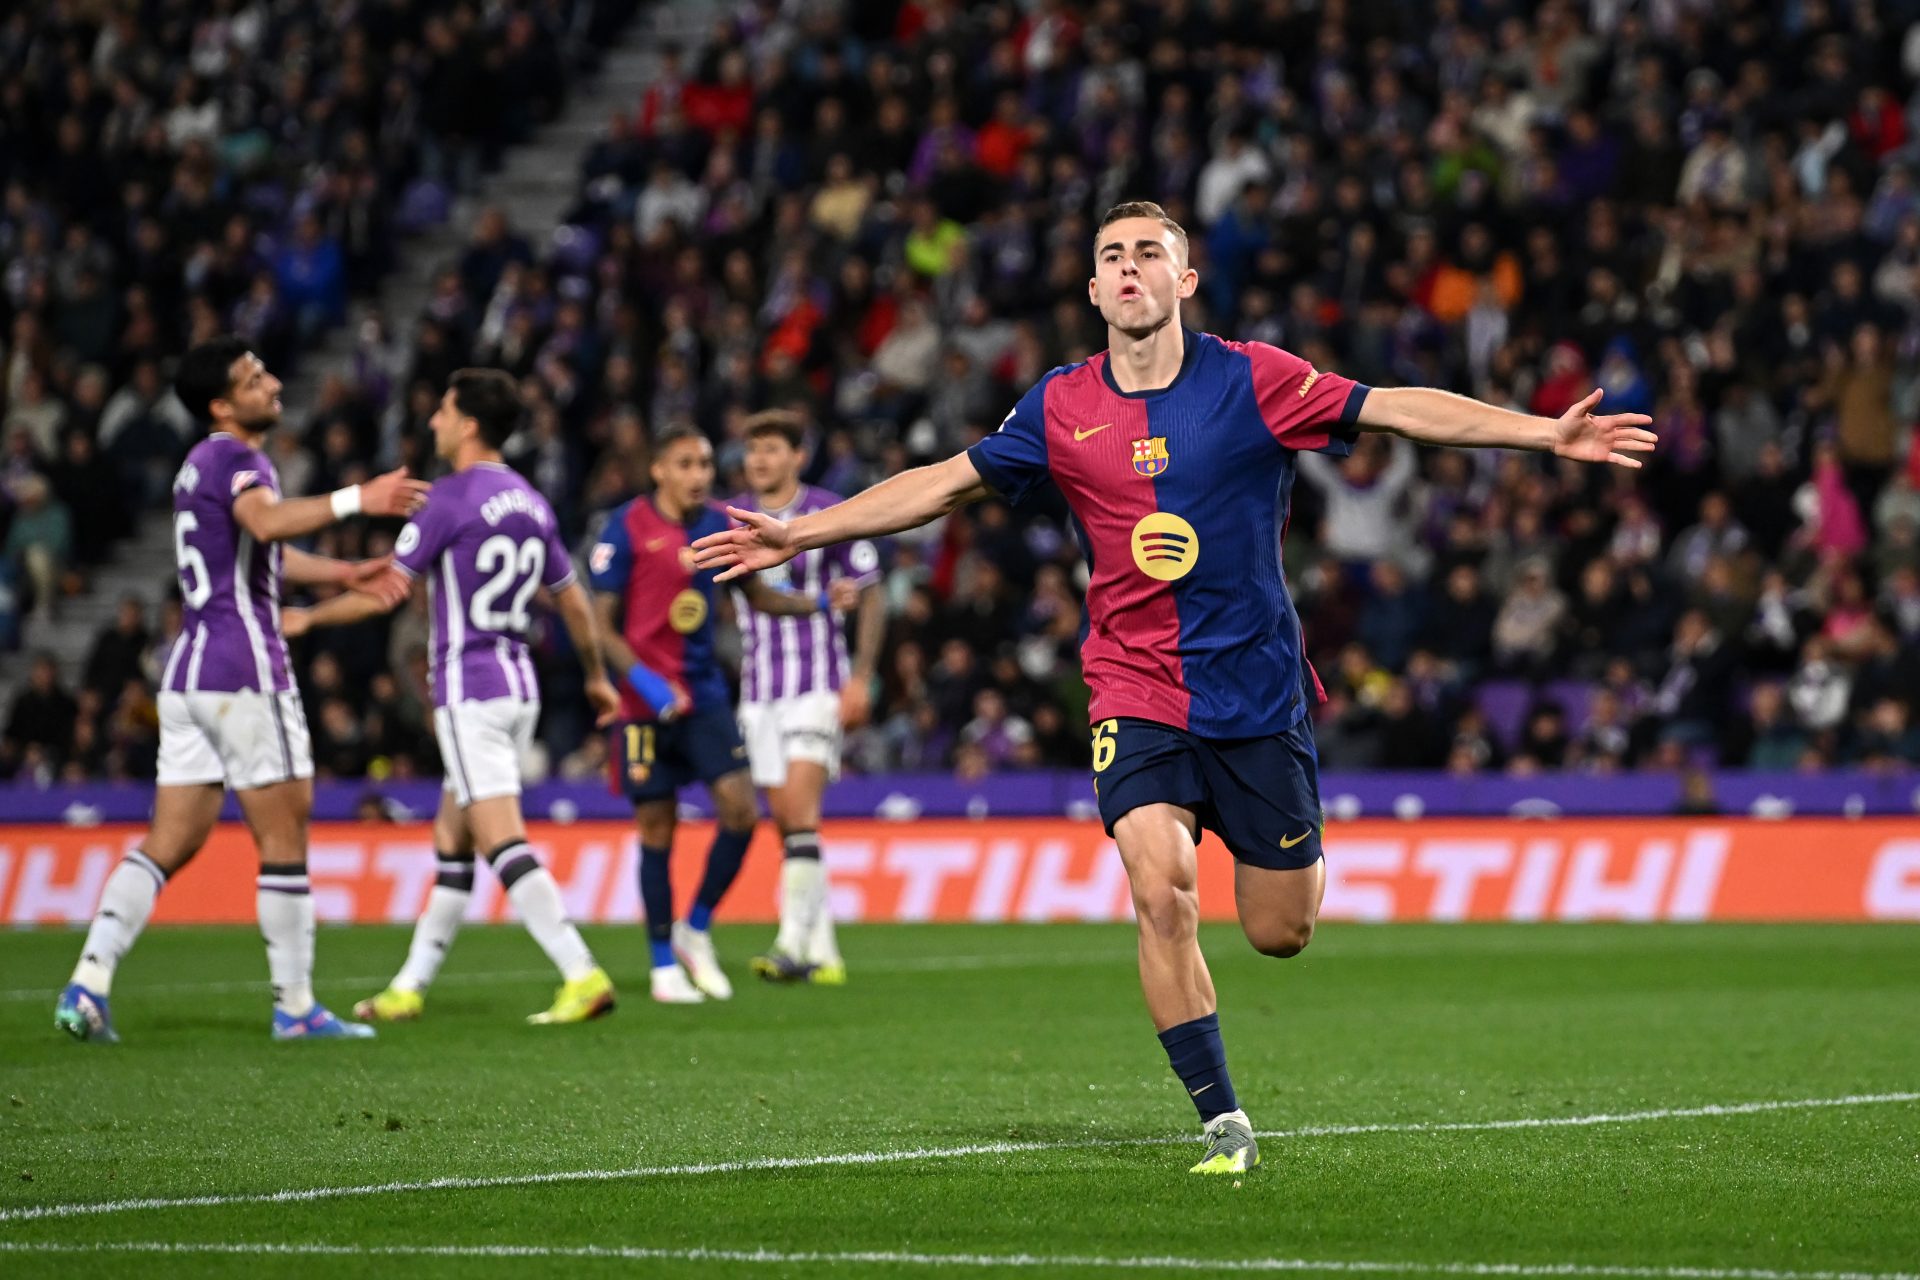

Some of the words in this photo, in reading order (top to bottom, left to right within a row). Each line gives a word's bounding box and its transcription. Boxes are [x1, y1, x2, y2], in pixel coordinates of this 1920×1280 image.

[174, 510, 212, 611] 5
[470, 534, 546, 632] 22
[624, 724, 656, 763] 11
[1092, 719, 1118, 772] 6
[822, 838, 1137, 921] STIH
[1322, 829, 1730, 921] STIHL
